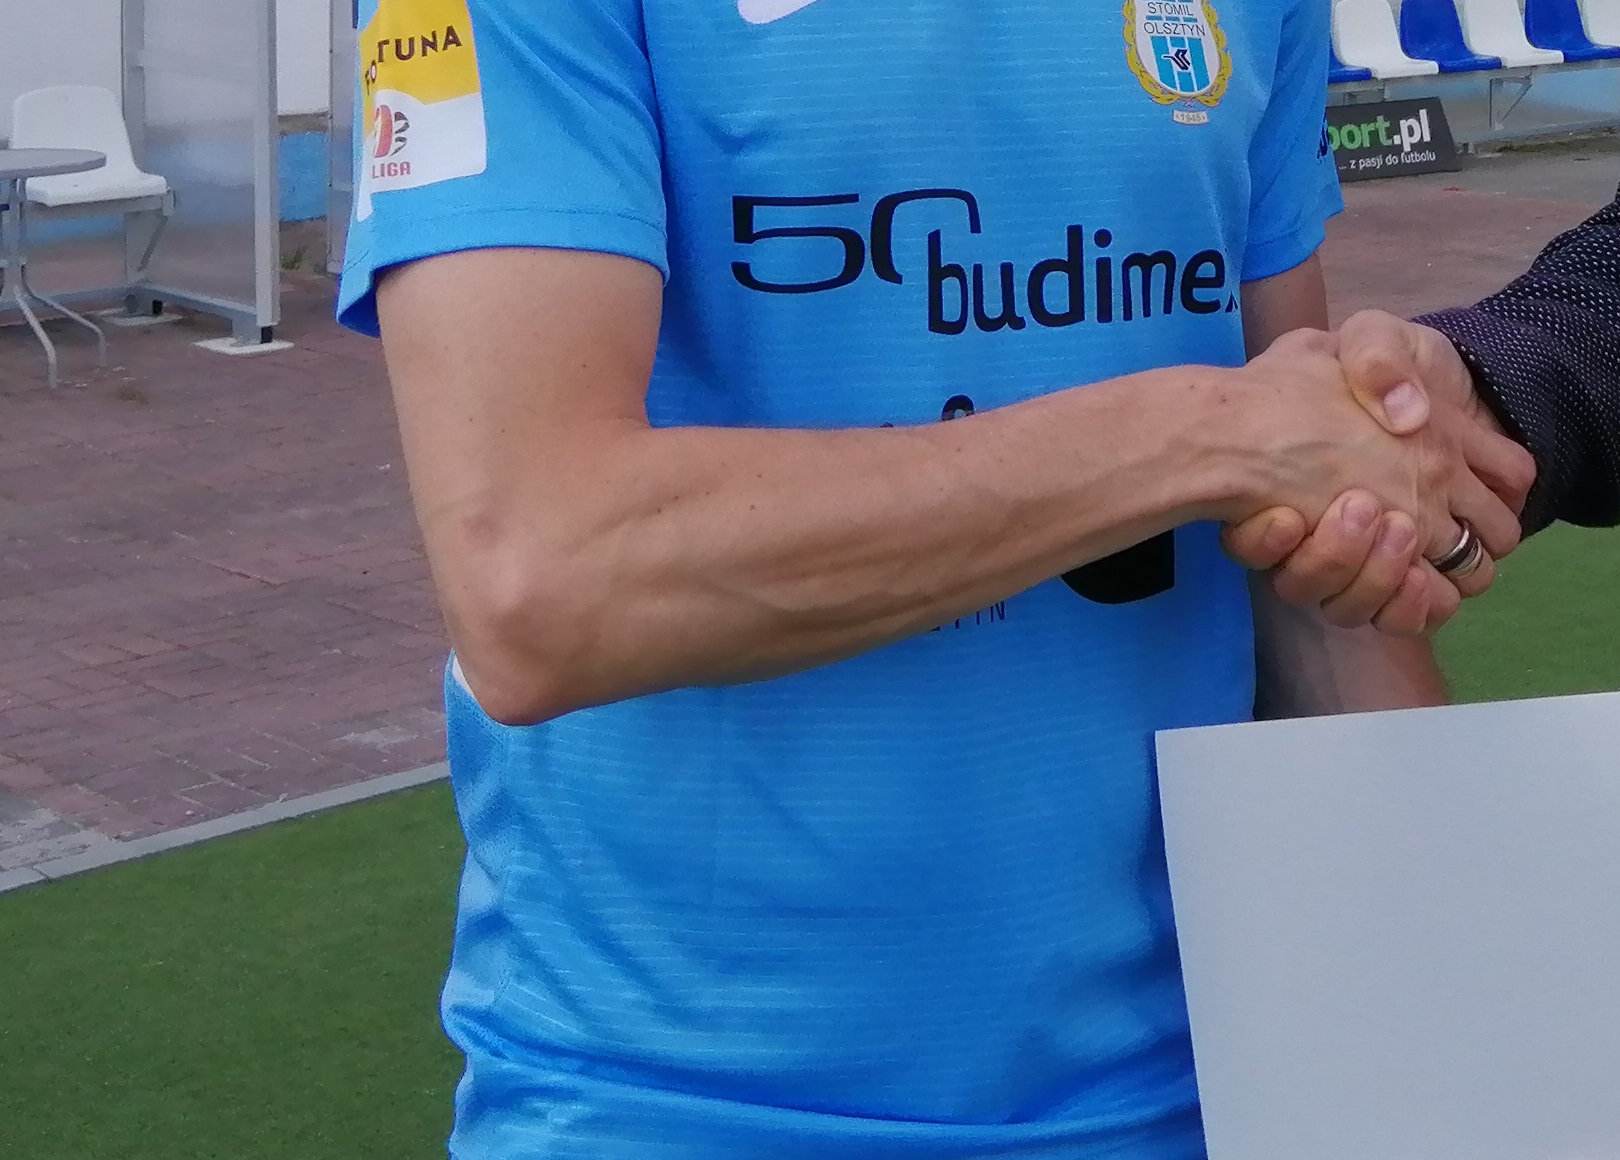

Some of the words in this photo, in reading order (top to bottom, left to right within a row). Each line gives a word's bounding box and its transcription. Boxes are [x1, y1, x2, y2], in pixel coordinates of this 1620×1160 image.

[1147, 1, 1194, 16] STOMIL
[1143, 21, 1206, 36] OLSZTYN
[364, 24, 463, 96] FOTUNA
[371, 161, 411, 179] LIGA
[1349, 159, 1357, 170] z
[1358, 155, 1383, 172] pasji
[1385, 153, 1399, 166] do
[1401, 149, 1436, 164] futbolu
[927, 224, 1239, 335] budime
